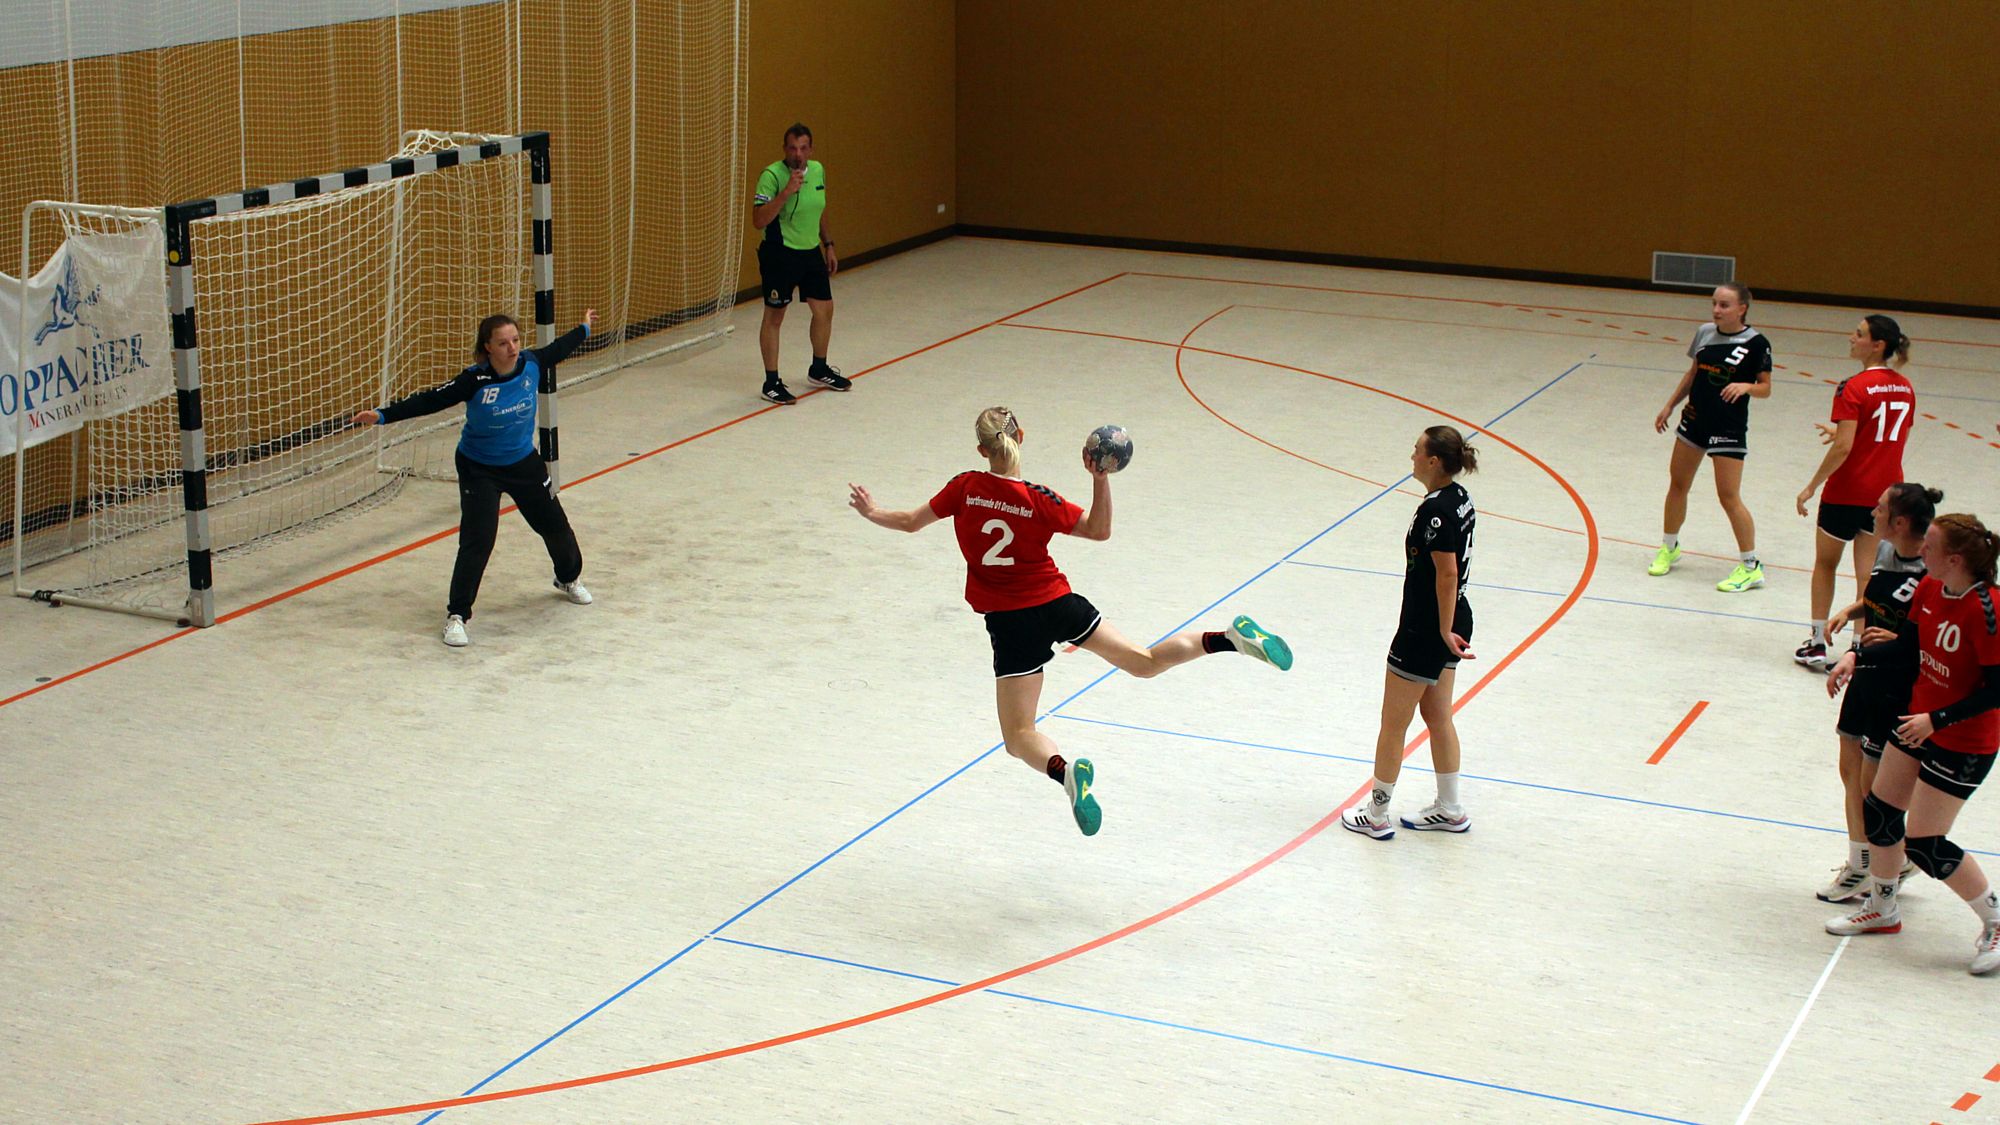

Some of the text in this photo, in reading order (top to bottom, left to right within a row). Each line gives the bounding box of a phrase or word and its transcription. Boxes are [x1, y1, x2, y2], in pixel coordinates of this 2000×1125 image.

[1724, 345, 1749, 366] 5
[0, 333, 150, 416] OPPACHER
[481, 387, 499, 404] 18
[1871, 401, 1910, 442] 17
[1020, 506, 1034, 518] Nord
[981, 519, 1015, 566] 2
[1934, 620, 1960, 653] 10
